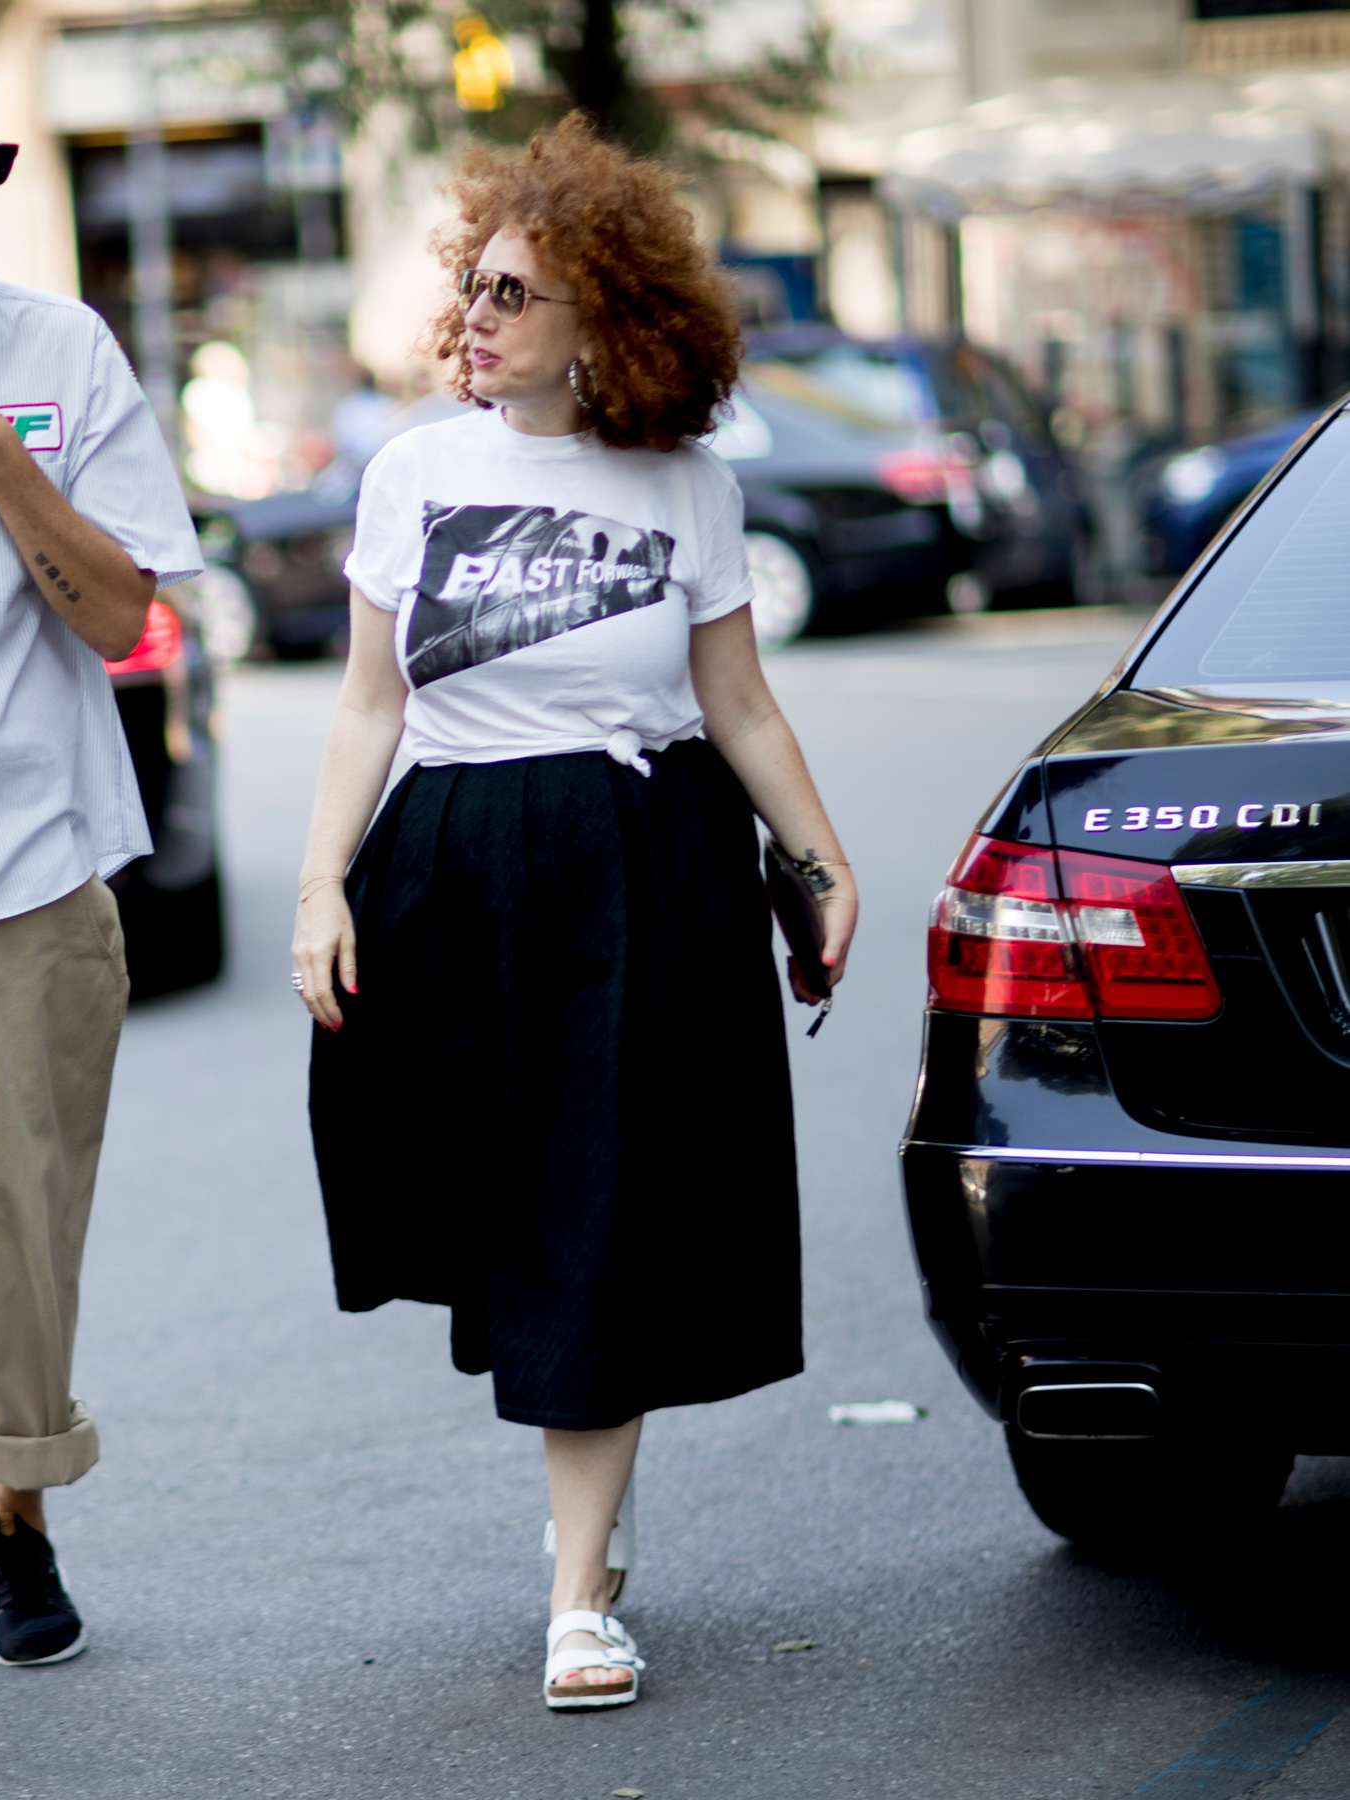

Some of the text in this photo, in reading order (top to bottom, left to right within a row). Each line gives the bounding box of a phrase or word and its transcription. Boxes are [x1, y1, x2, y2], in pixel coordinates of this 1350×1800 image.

[1084, 803, 1322, 831] E 350 CDI
